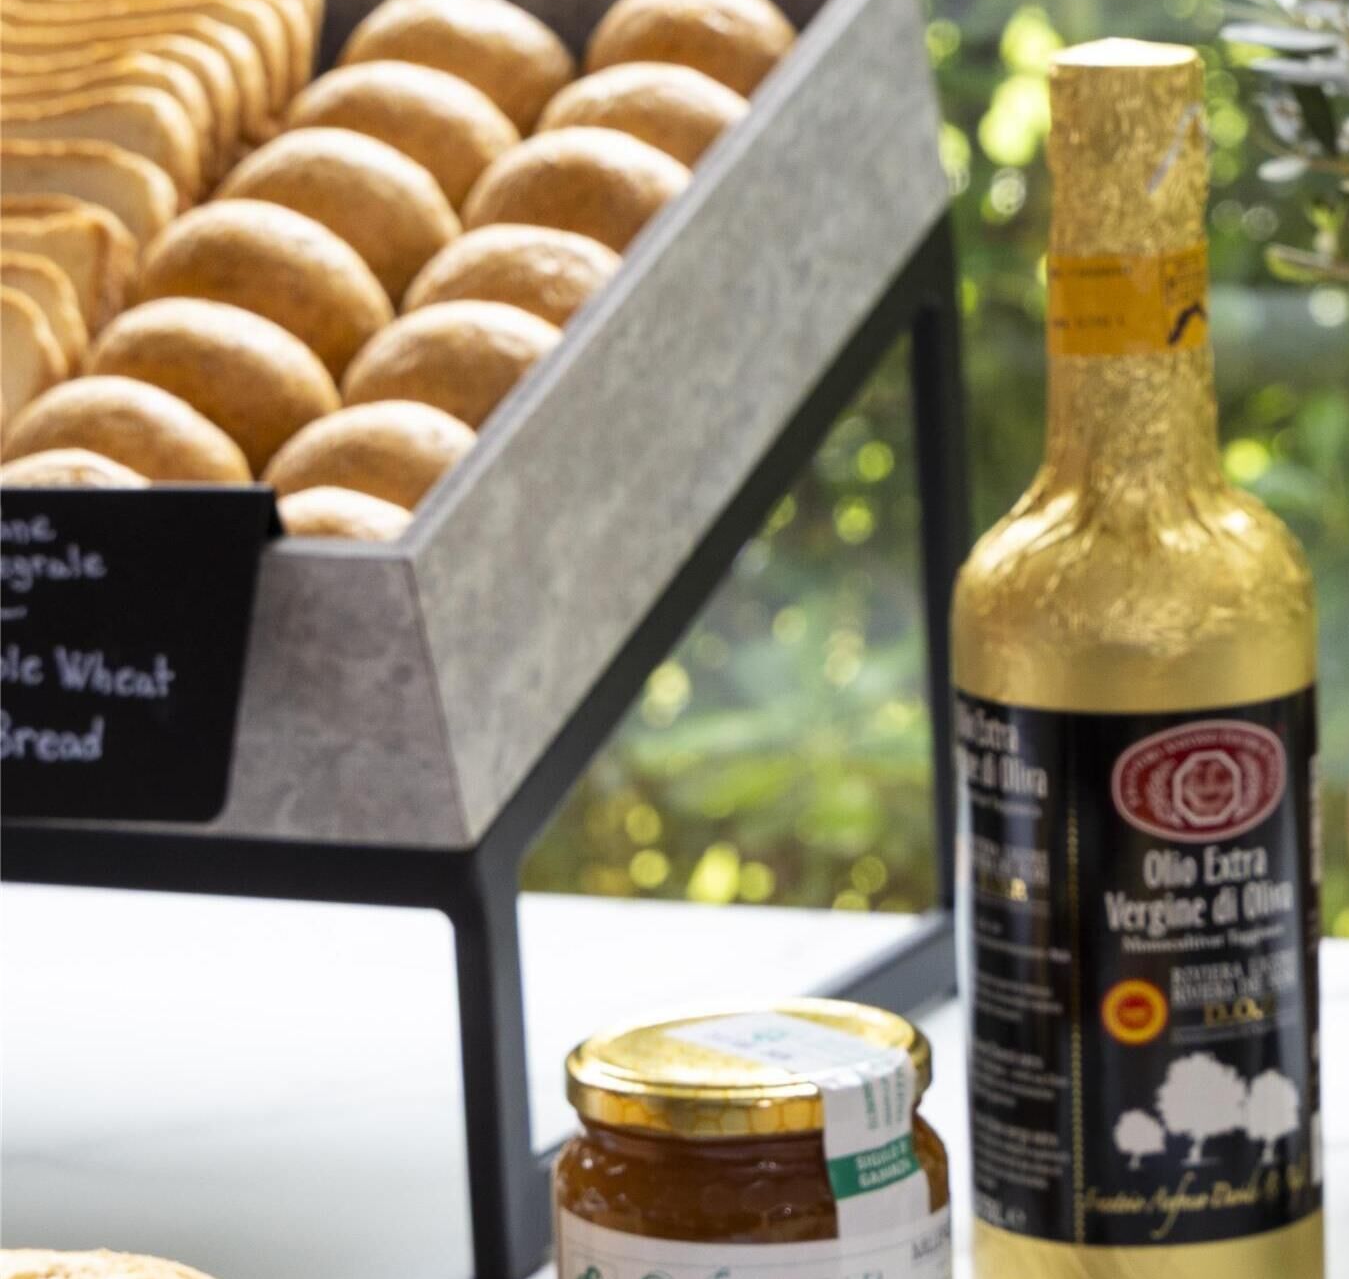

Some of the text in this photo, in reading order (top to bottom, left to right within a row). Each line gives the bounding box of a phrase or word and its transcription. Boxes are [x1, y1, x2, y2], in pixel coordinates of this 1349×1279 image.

[54, 644, 176, 698] Wheat
[1142, 844, 1269, 890] Olio Extra
[1104, 879, 1294, 938] Vergine di Oliva
